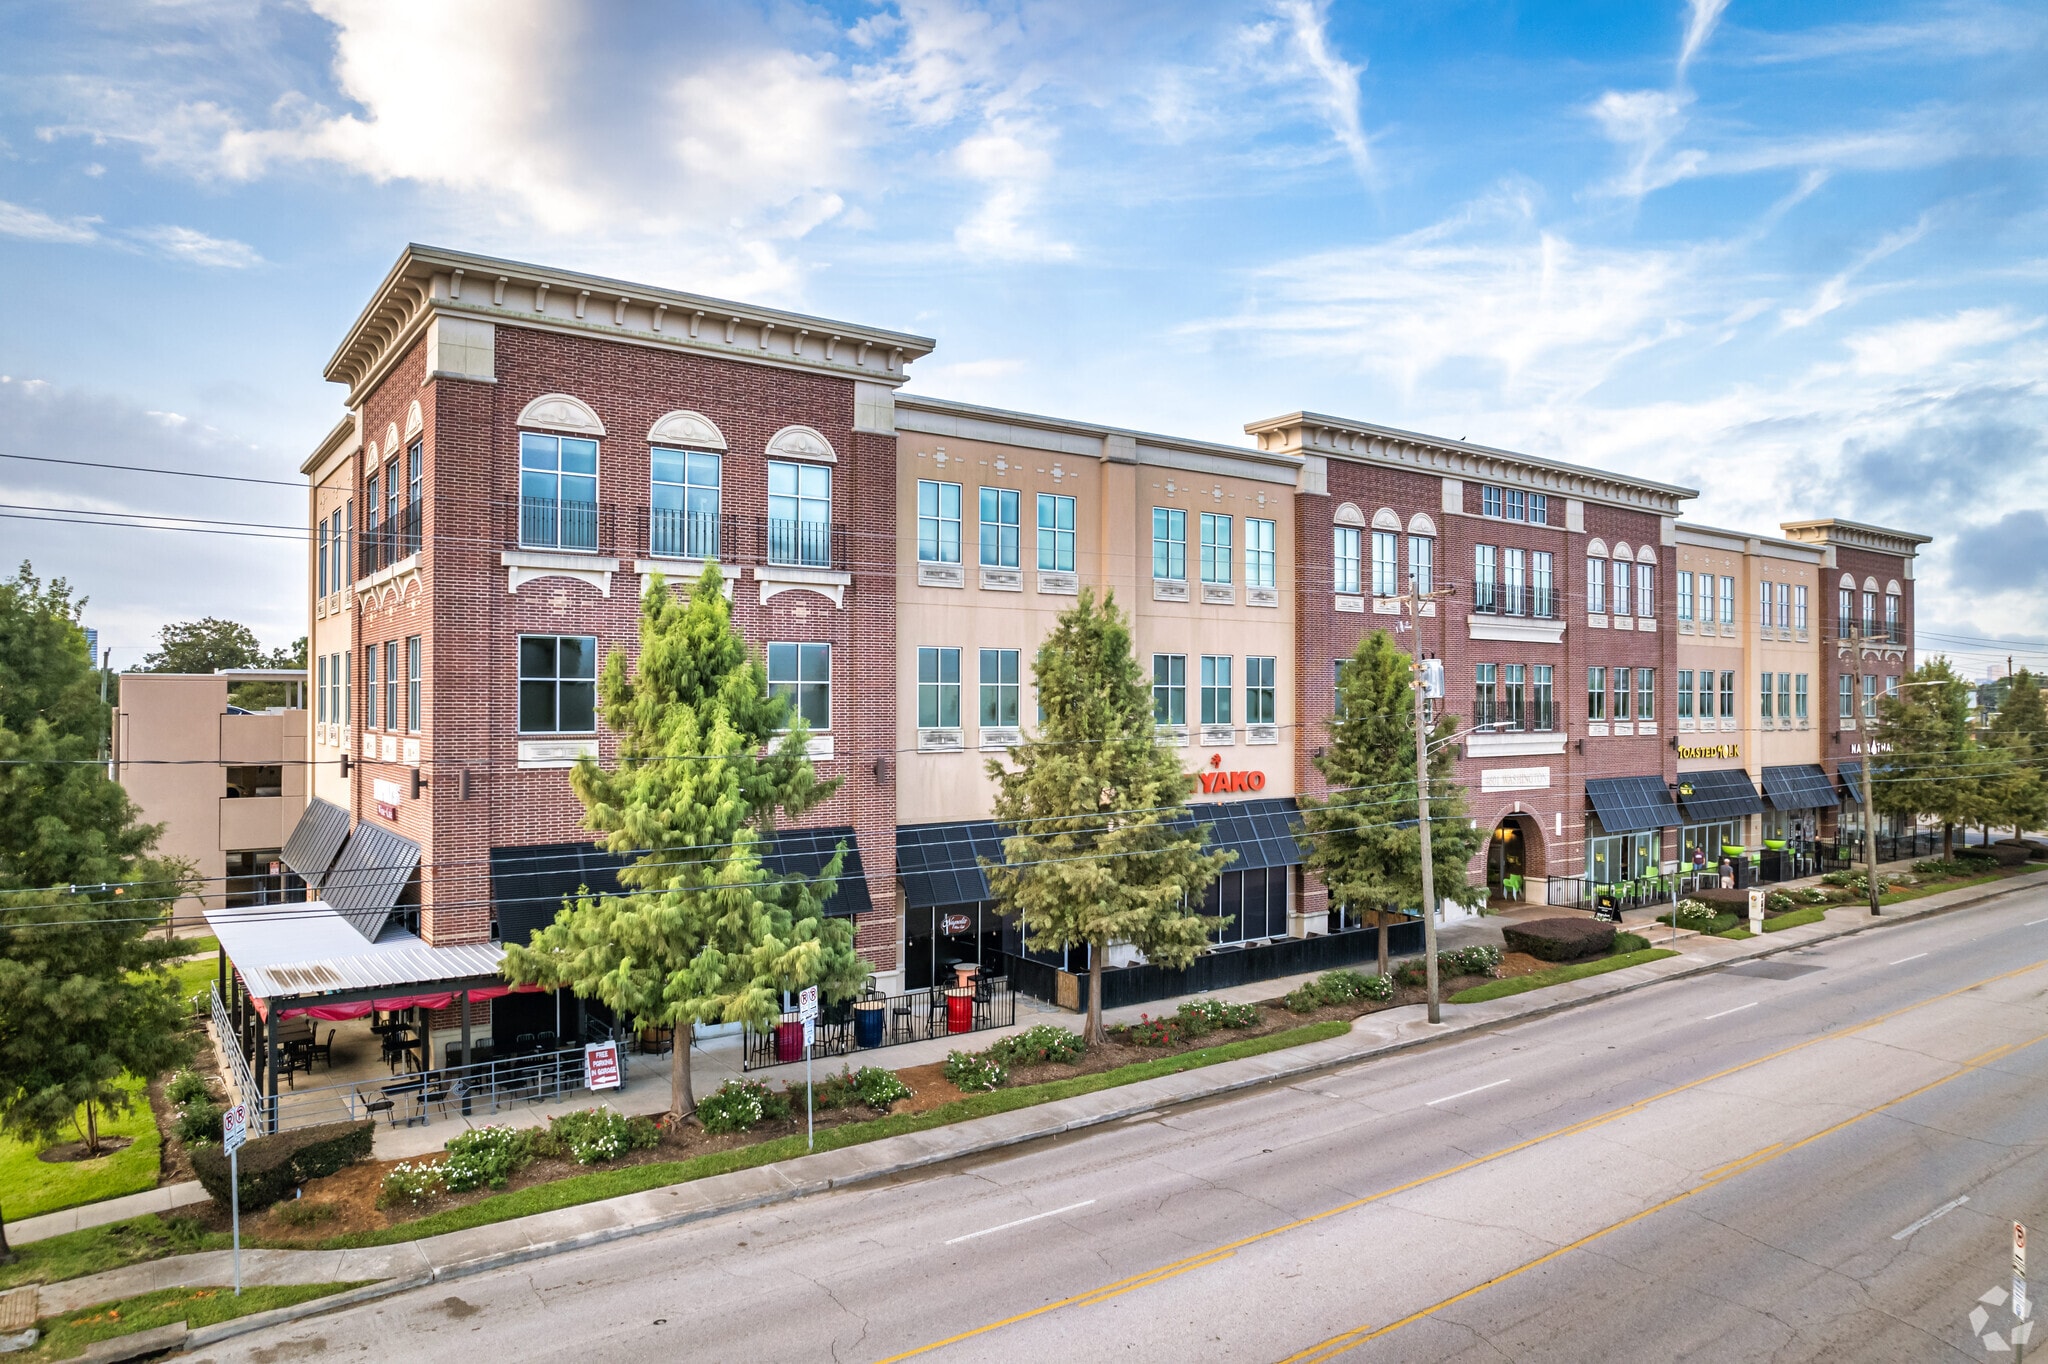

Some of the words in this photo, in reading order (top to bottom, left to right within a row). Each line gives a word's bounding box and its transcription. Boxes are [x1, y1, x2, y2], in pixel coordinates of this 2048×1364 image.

[1678, 745, 1717, 759] TOASTED
[592, 1059, 613, 1067] PARKING
[597, 1067, 616, 1075] GARAGE
